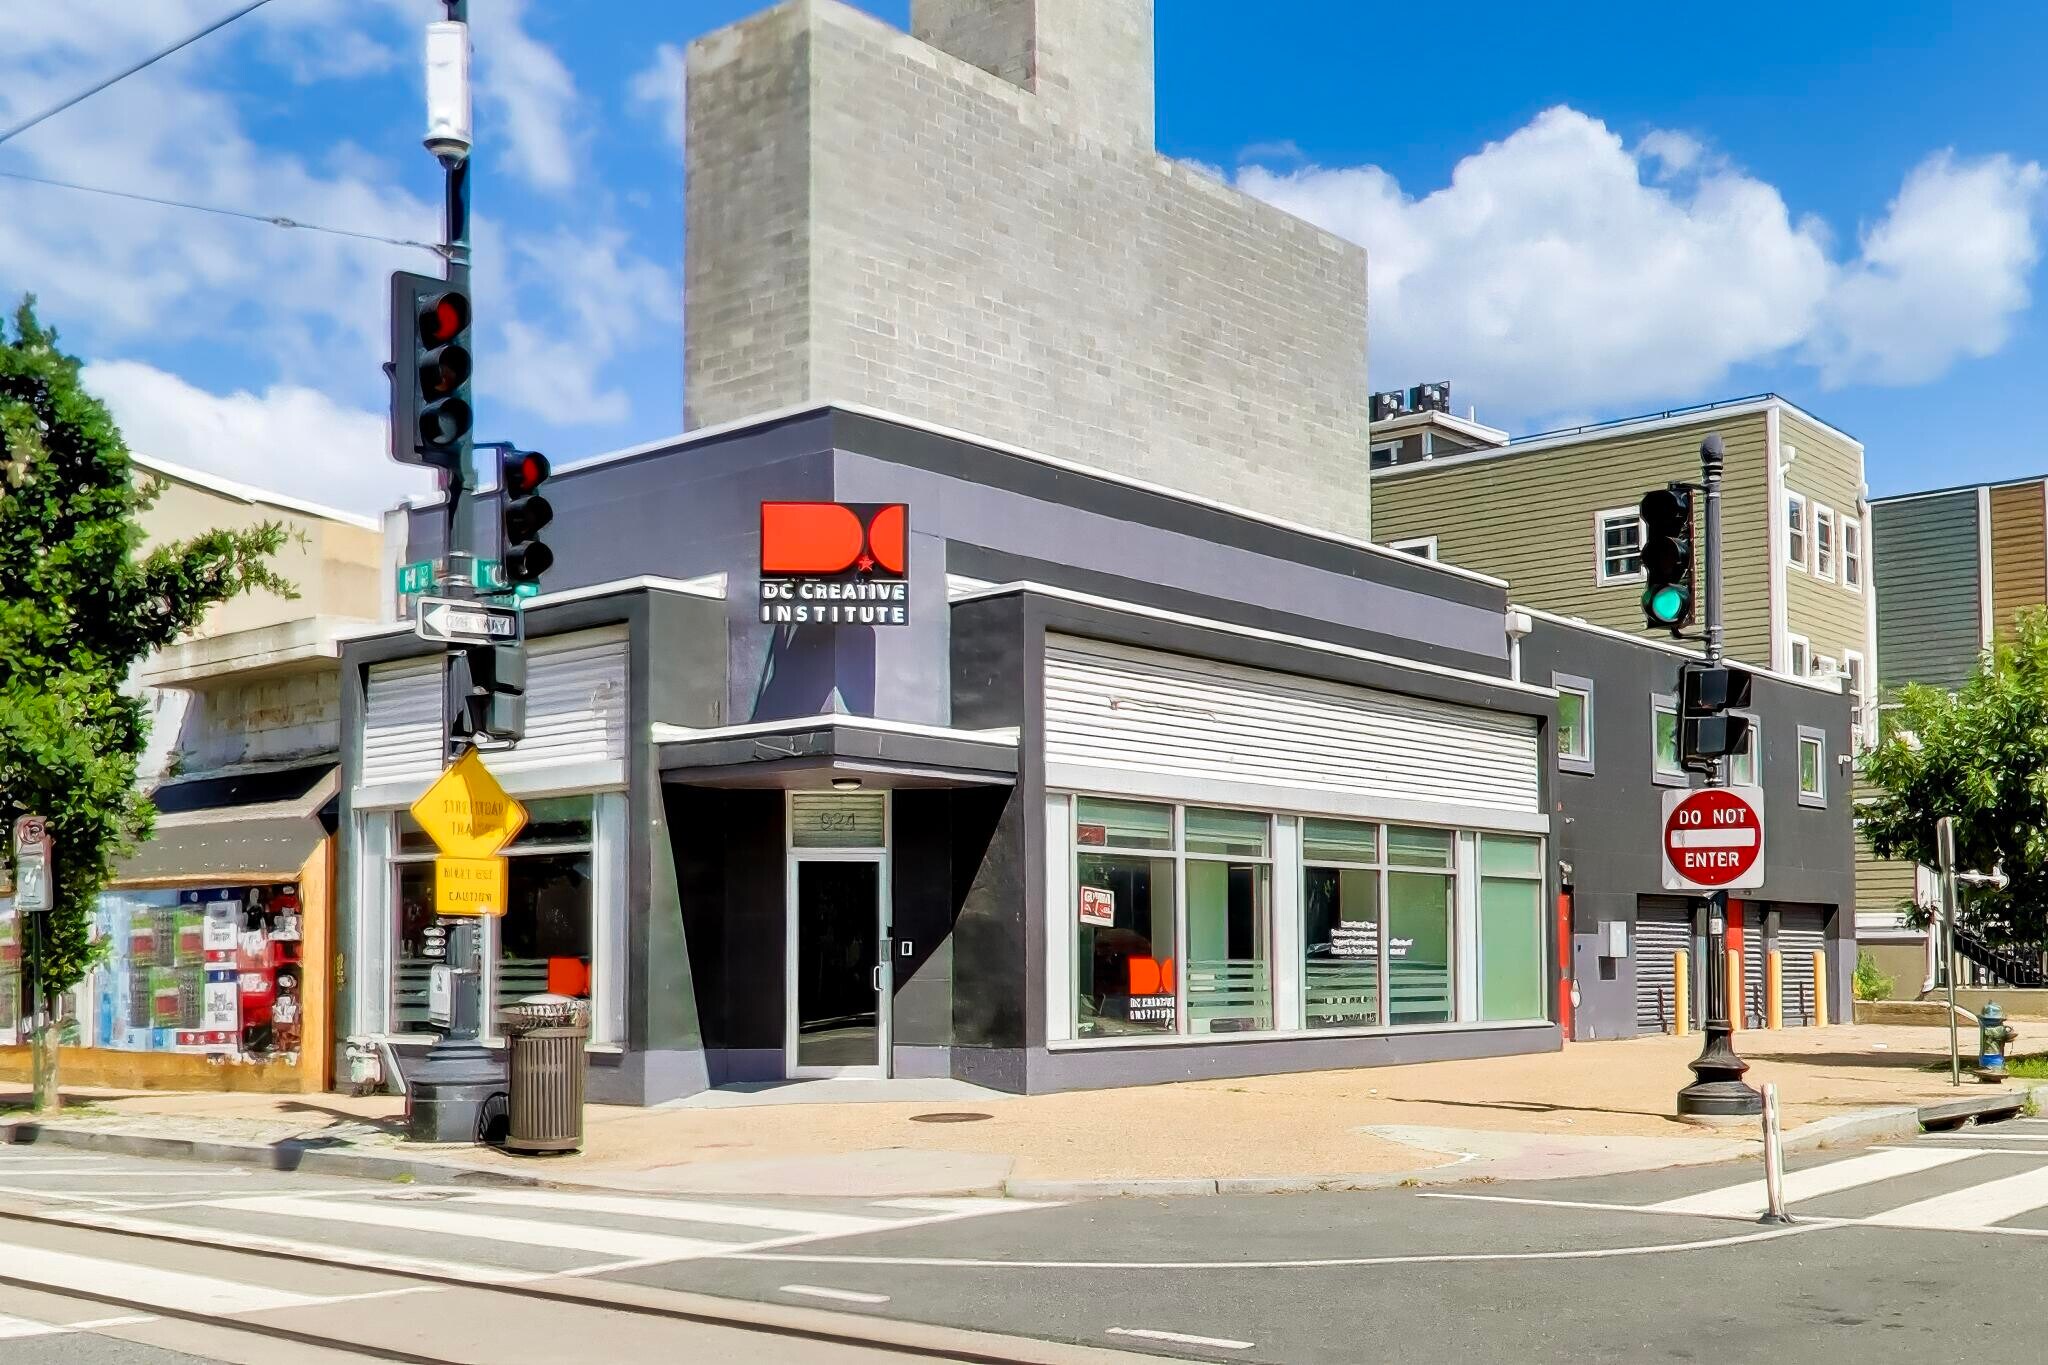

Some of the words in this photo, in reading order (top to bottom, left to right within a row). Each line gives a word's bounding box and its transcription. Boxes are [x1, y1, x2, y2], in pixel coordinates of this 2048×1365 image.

[763, 584, 794, 601] DC
[799, 584, 904, 601] CREATIVE
[763, 605, 905, 623] INSTITUTE
[1679, 809, 1702, 825] DO
[1713, 808, 1746, 825] NOT
[1684, 852, 1740, 868] ENTER
